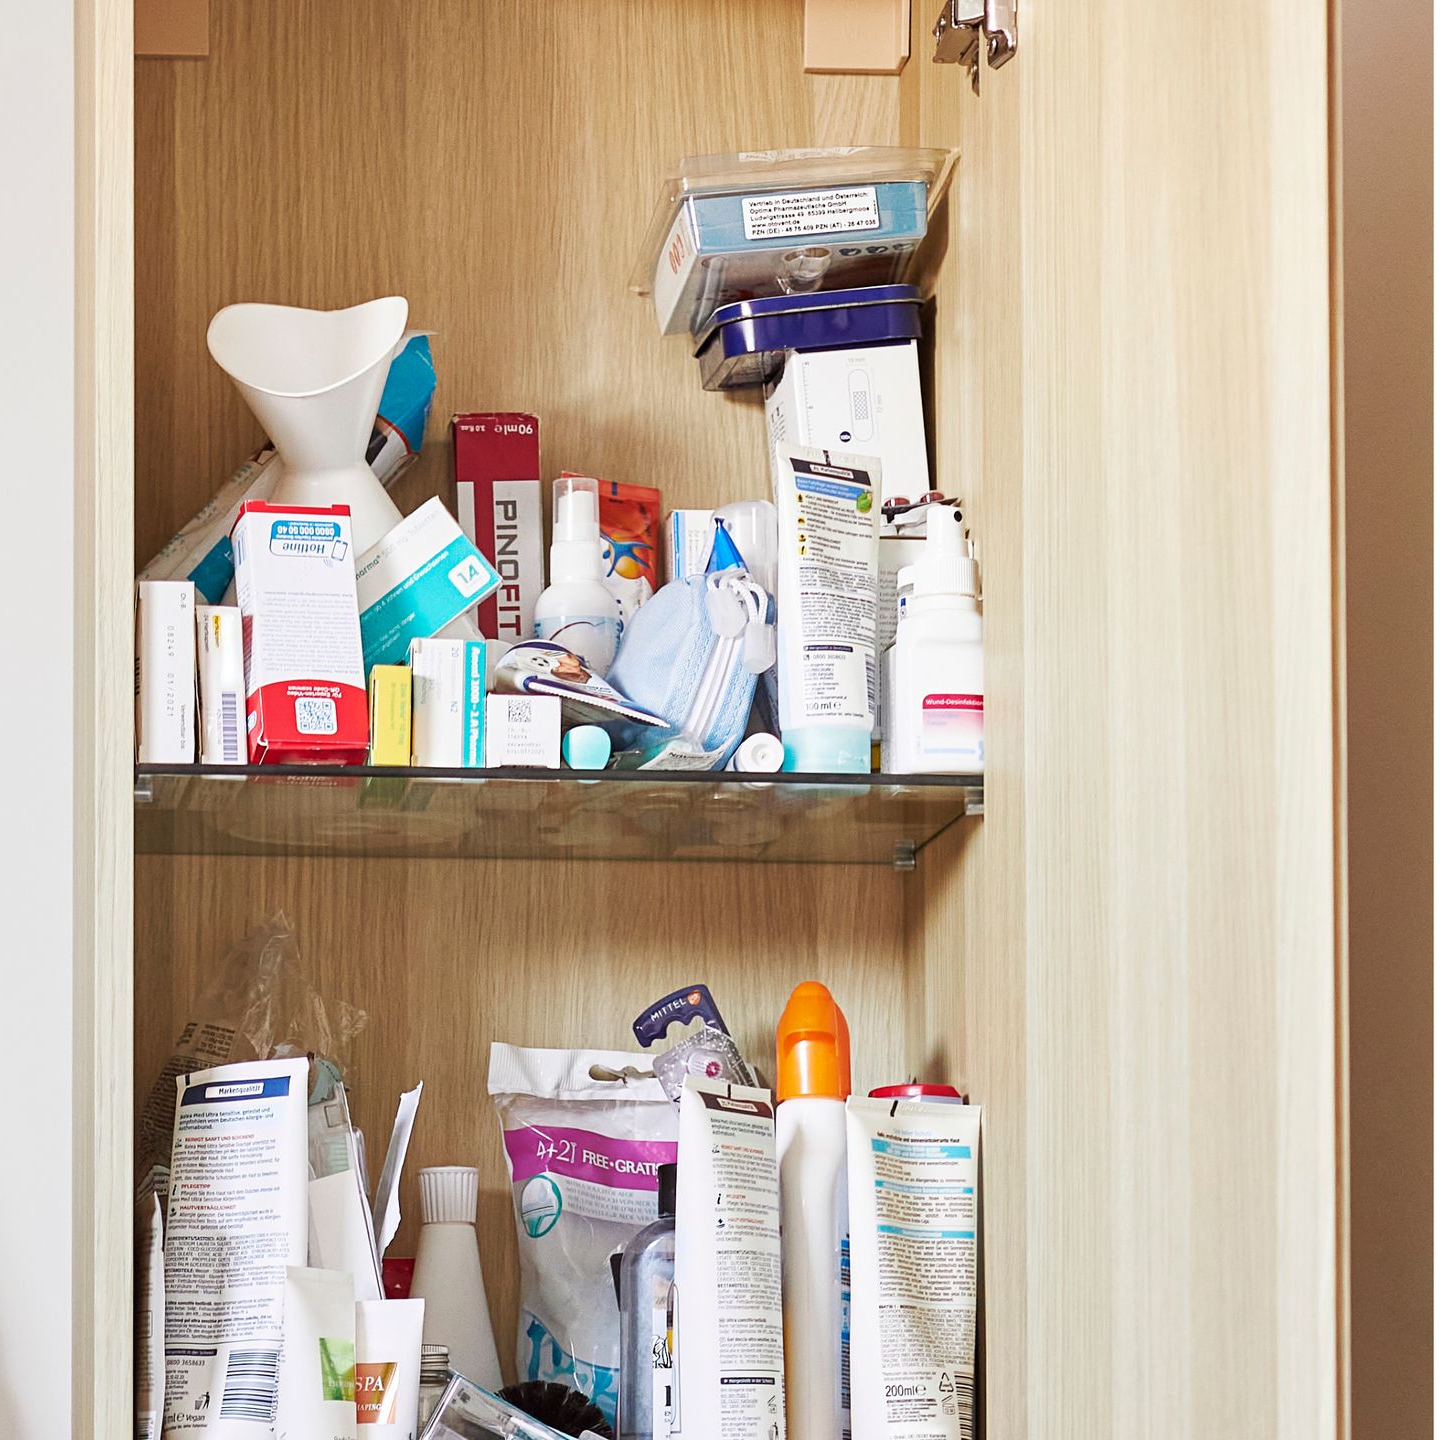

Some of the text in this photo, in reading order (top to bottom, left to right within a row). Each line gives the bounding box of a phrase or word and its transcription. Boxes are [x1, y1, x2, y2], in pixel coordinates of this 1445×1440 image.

[283, 542, 326, 554] Hotline
[496, 500, 522, 636] PINOFIT
[651, 998, 687, 1022] MITTEL
[219, 1085, 260, 1094] Markenqualität
[356, 1376, 384, 1392] SPA
